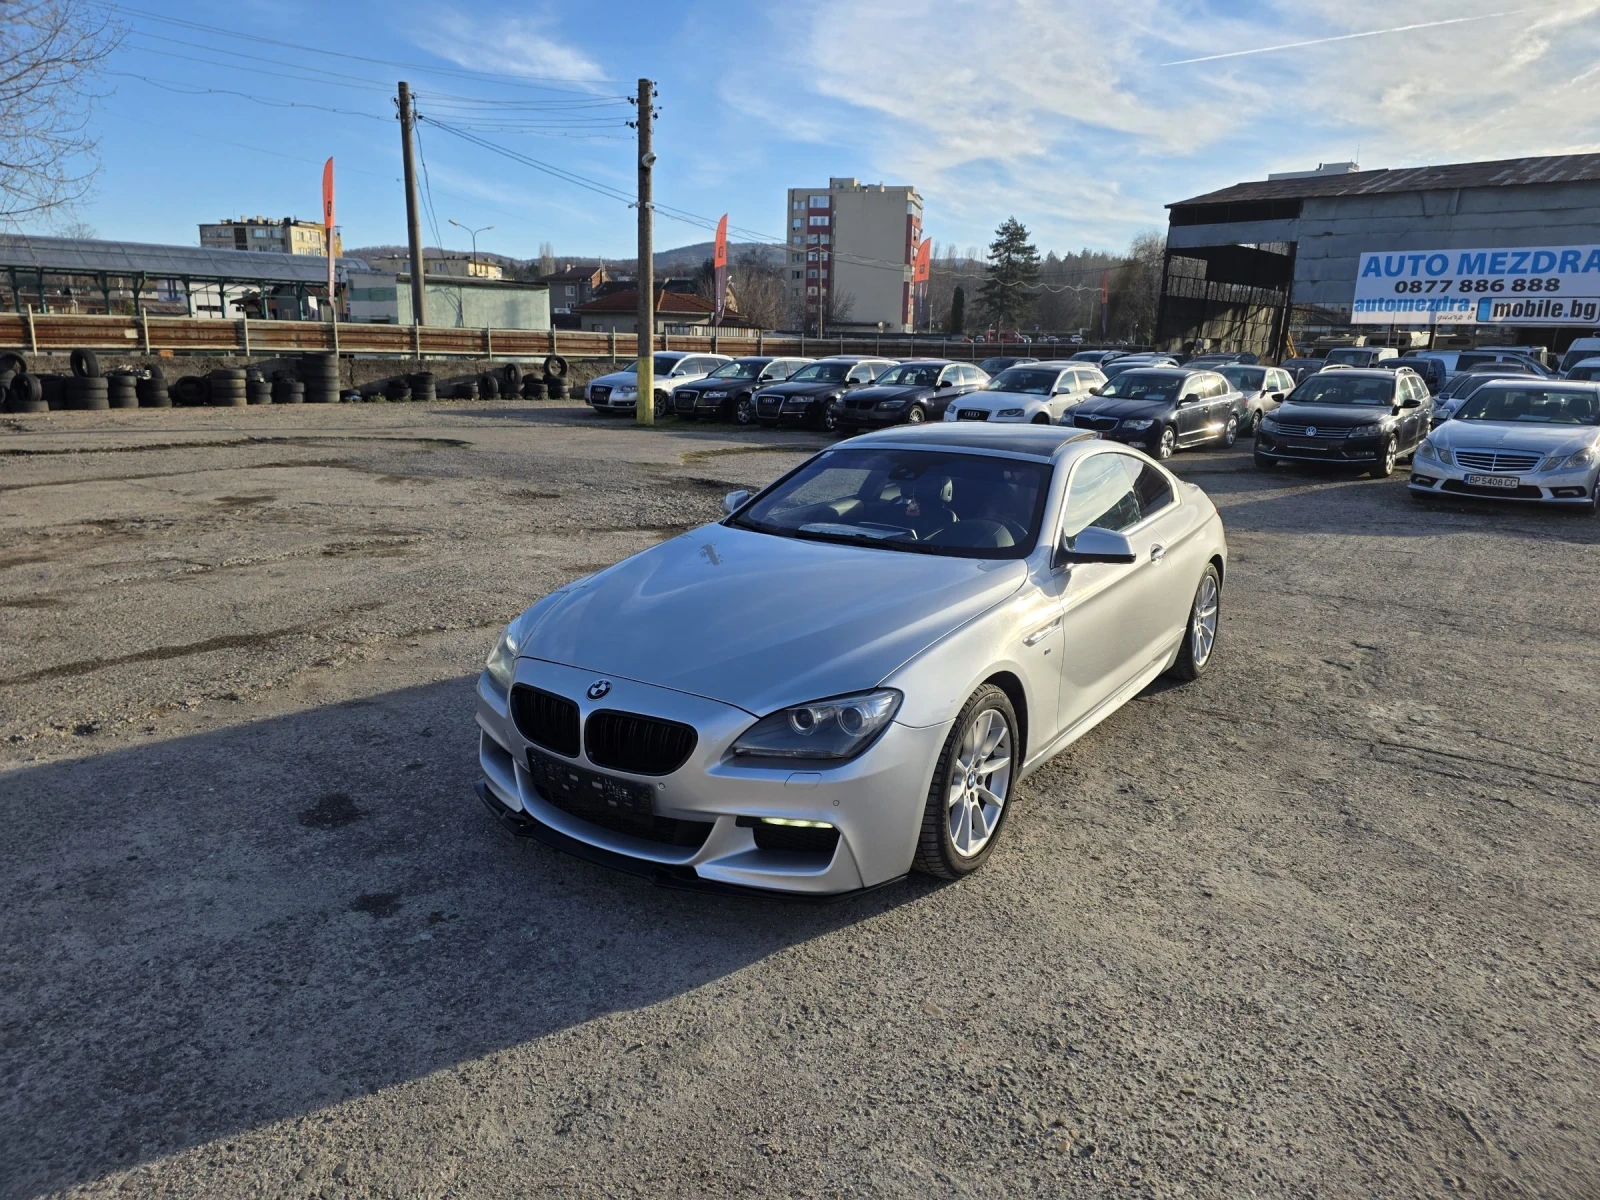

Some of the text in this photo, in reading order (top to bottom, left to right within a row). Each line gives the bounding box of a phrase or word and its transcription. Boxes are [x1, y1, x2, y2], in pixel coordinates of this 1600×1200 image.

[1361, 249, 1600, 278] AUTO MEZDRA
[1394, 277, 1560, 293] 0877 886 888
[1492, 299, 1597, 320] mobile.bg
